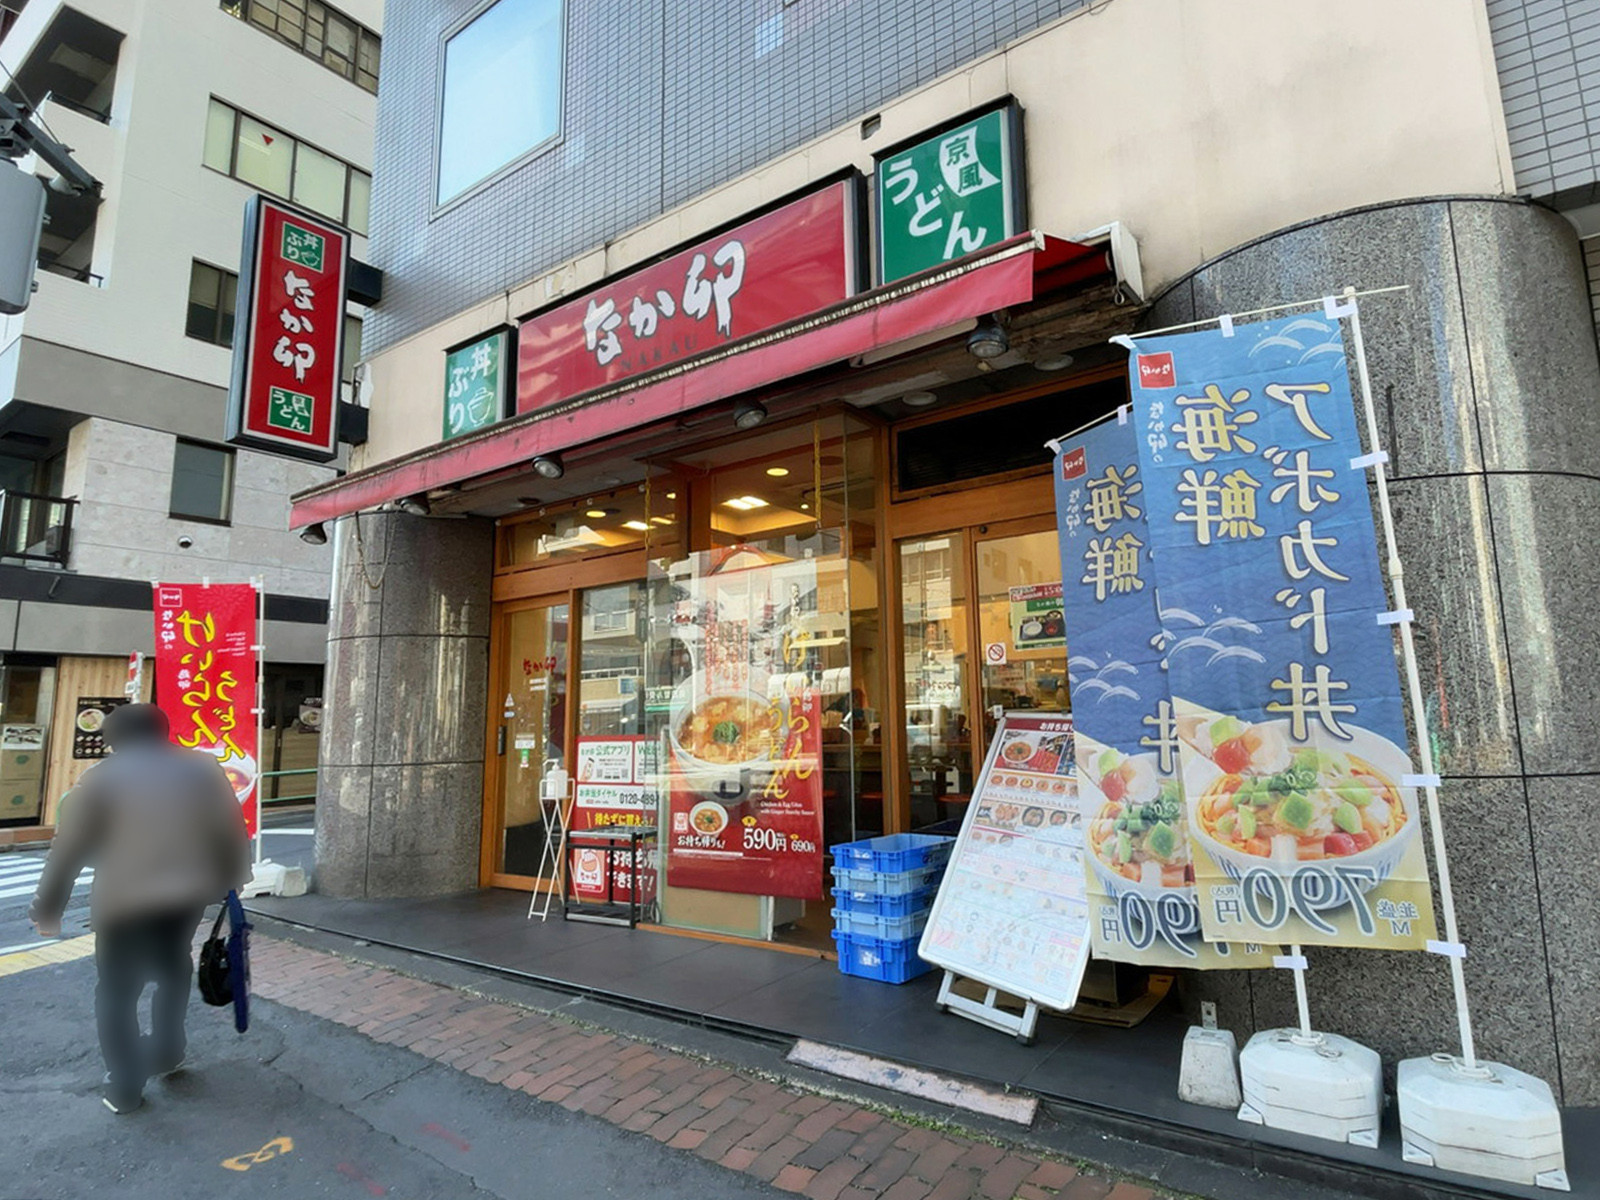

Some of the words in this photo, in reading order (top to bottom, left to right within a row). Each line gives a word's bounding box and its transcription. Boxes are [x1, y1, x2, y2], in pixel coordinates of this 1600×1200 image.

[885, 156, 987, 261] うどん
[272, 270, 316, 384] なか卯
[583, 239, 746, 367] なか卯
[273, 390, 306, 430] うどん
